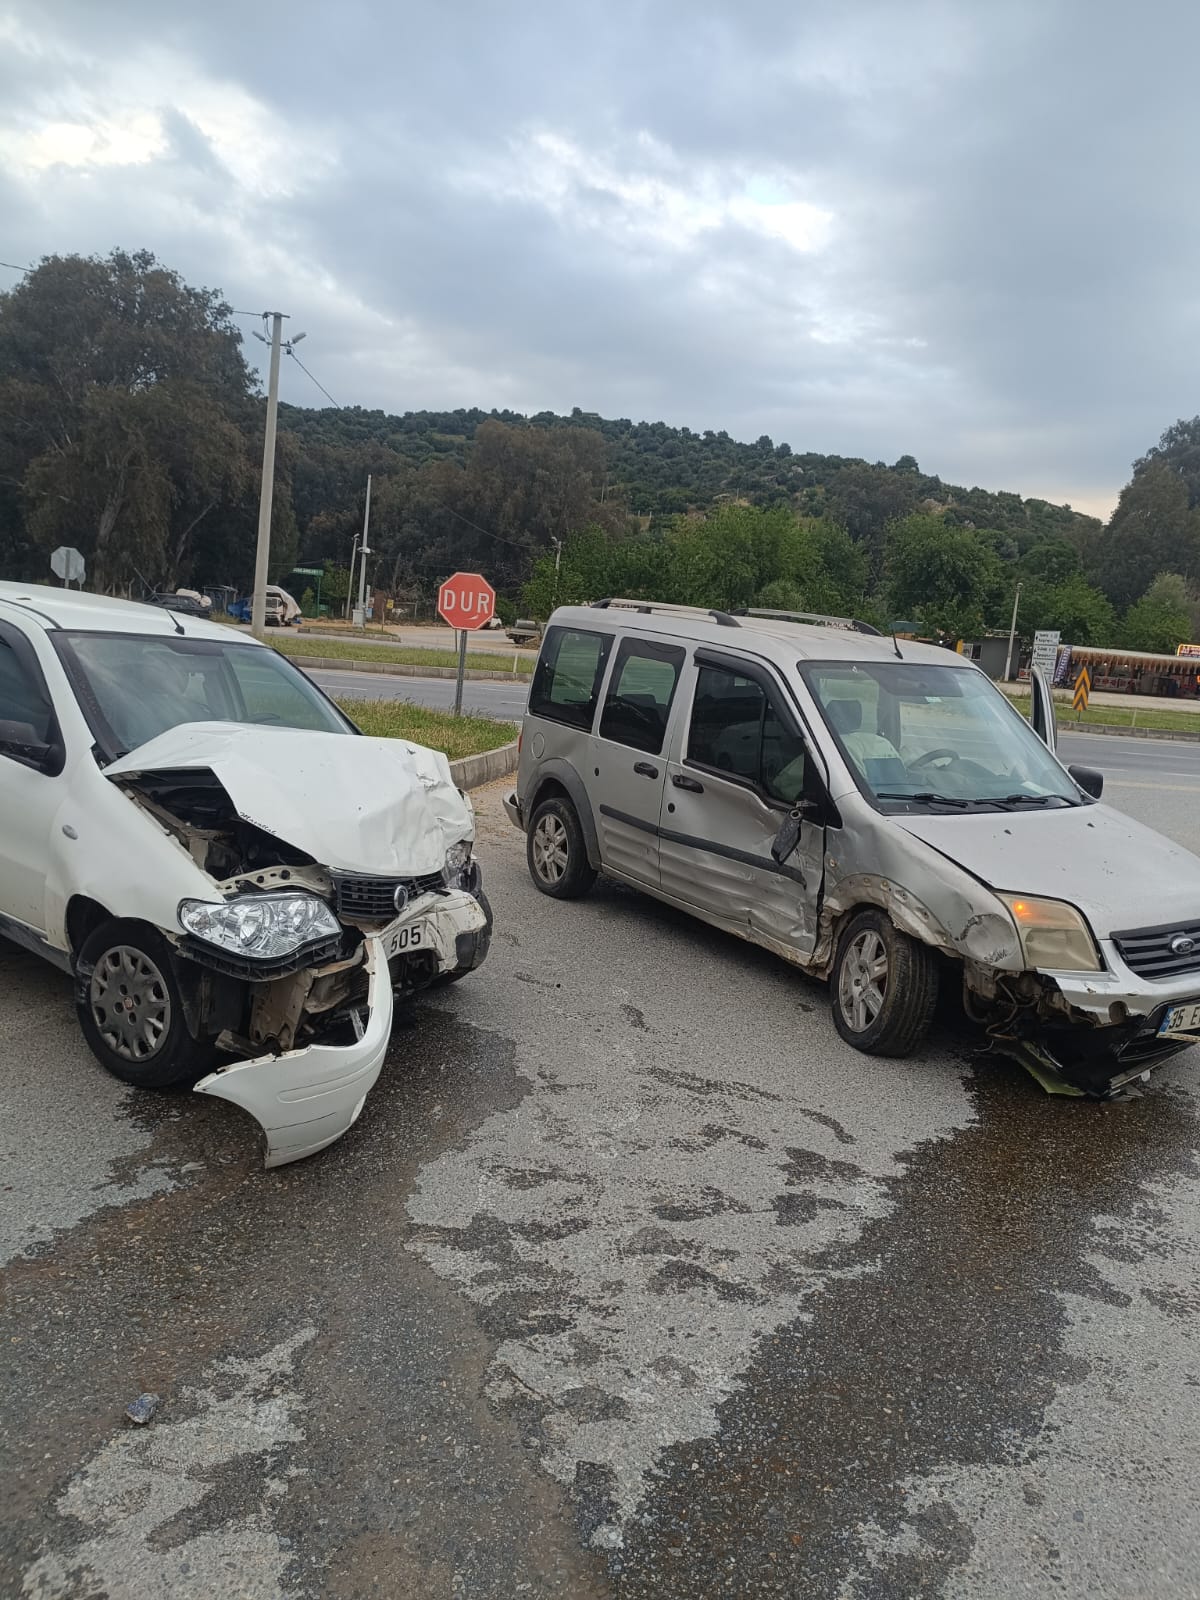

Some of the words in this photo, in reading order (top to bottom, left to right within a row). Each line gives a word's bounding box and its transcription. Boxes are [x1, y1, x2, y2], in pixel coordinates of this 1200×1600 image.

[443, 589, 490, 615] DUR
[391, 925, 421, 953] 505
[1168, 1008, 1186, 1029] 35
[1190, 1006, 1200, 1026] E
